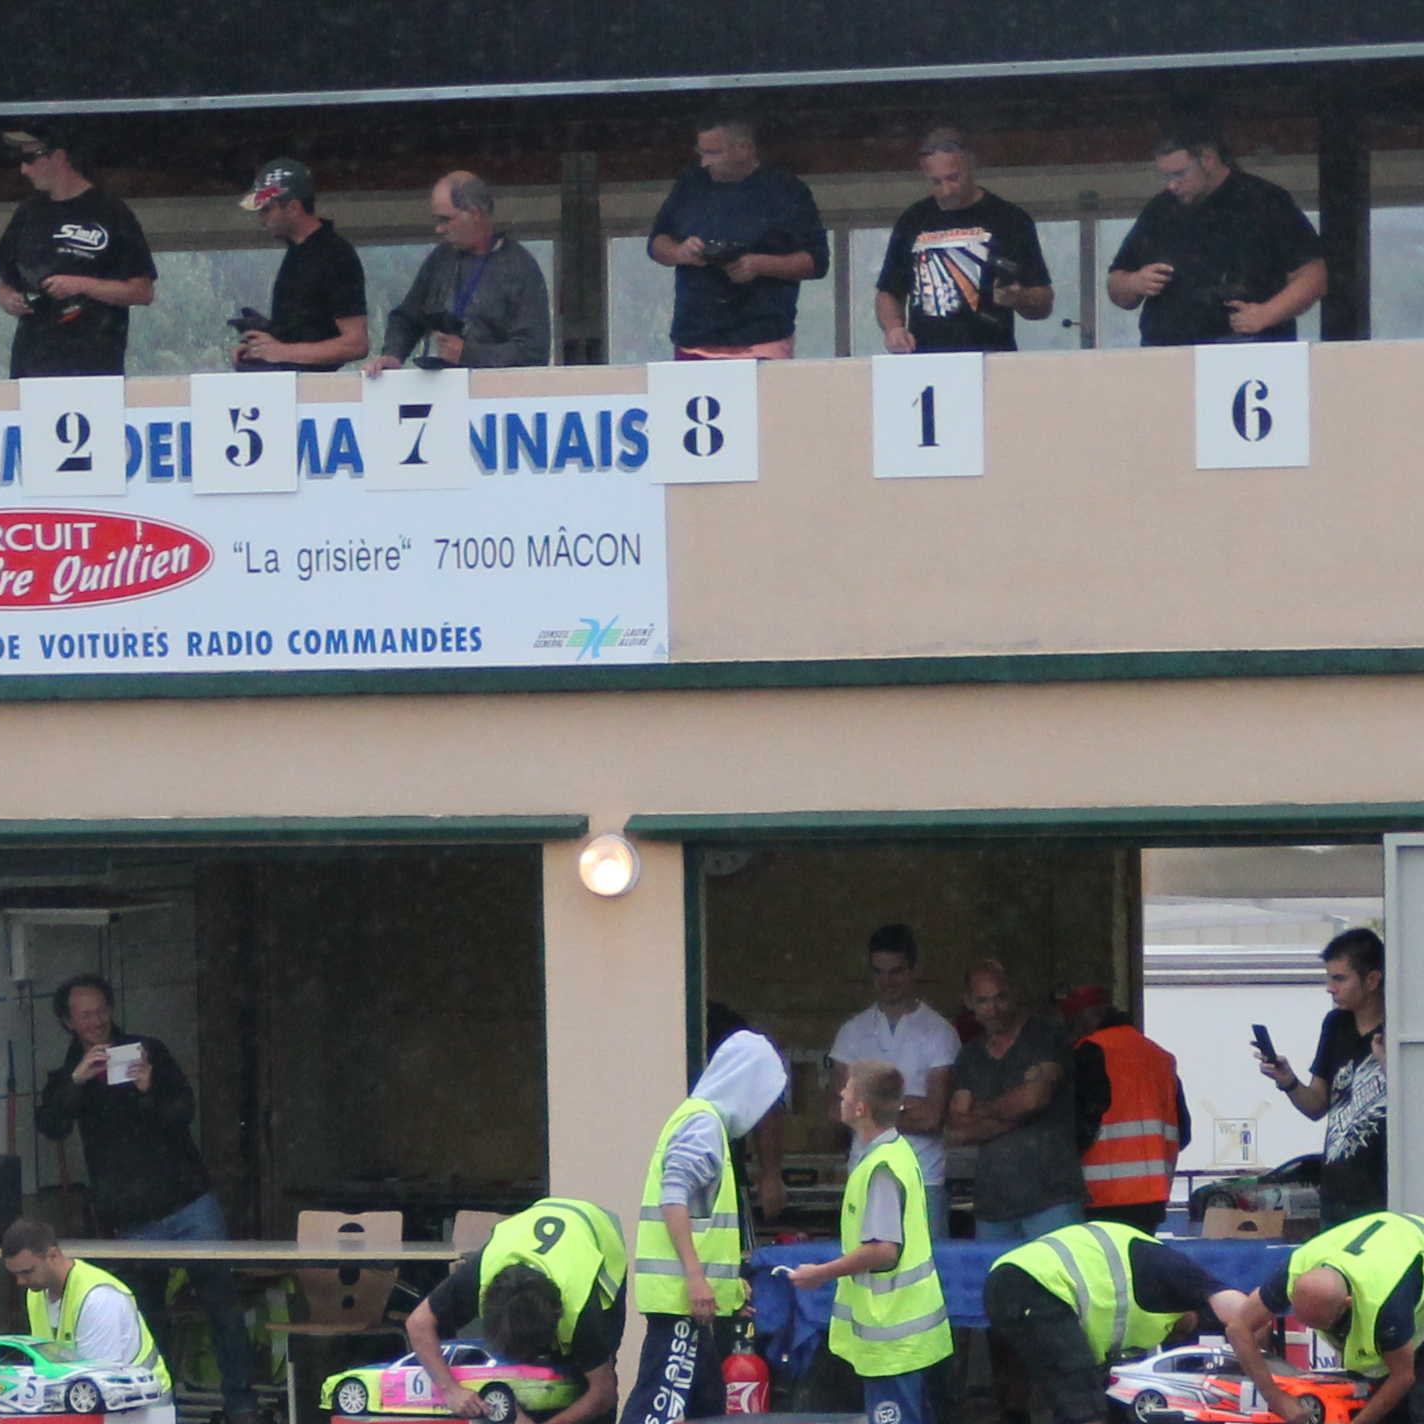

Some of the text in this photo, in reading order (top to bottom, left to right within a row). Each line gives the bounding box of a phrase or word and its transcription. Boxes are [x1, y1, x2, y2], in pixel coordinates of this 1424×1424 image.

[225, 407, 264, 467] 5
[398, 403, 433, 465] 7
[682, 395, 724, 457] 8
[913, 386, 940, 447] 1
[1232, 380, 1273, 442] 6
[55, 412, 93, 472] 2
[49, 543, 192, 602] Quillien
[434, 536, 515, 570] 71000
[527, 526, 642, 568] MÂCON
[39, 631, 169, 660] VOITURES
[187, 630, 273, 657] RADIO
[287, 621, 482, 655] COMMANDÉES
[664, 1318, 690, 1382] este
[24, 1376, 38, 1400] 5
[412, 1372, 425, 1396] 6
